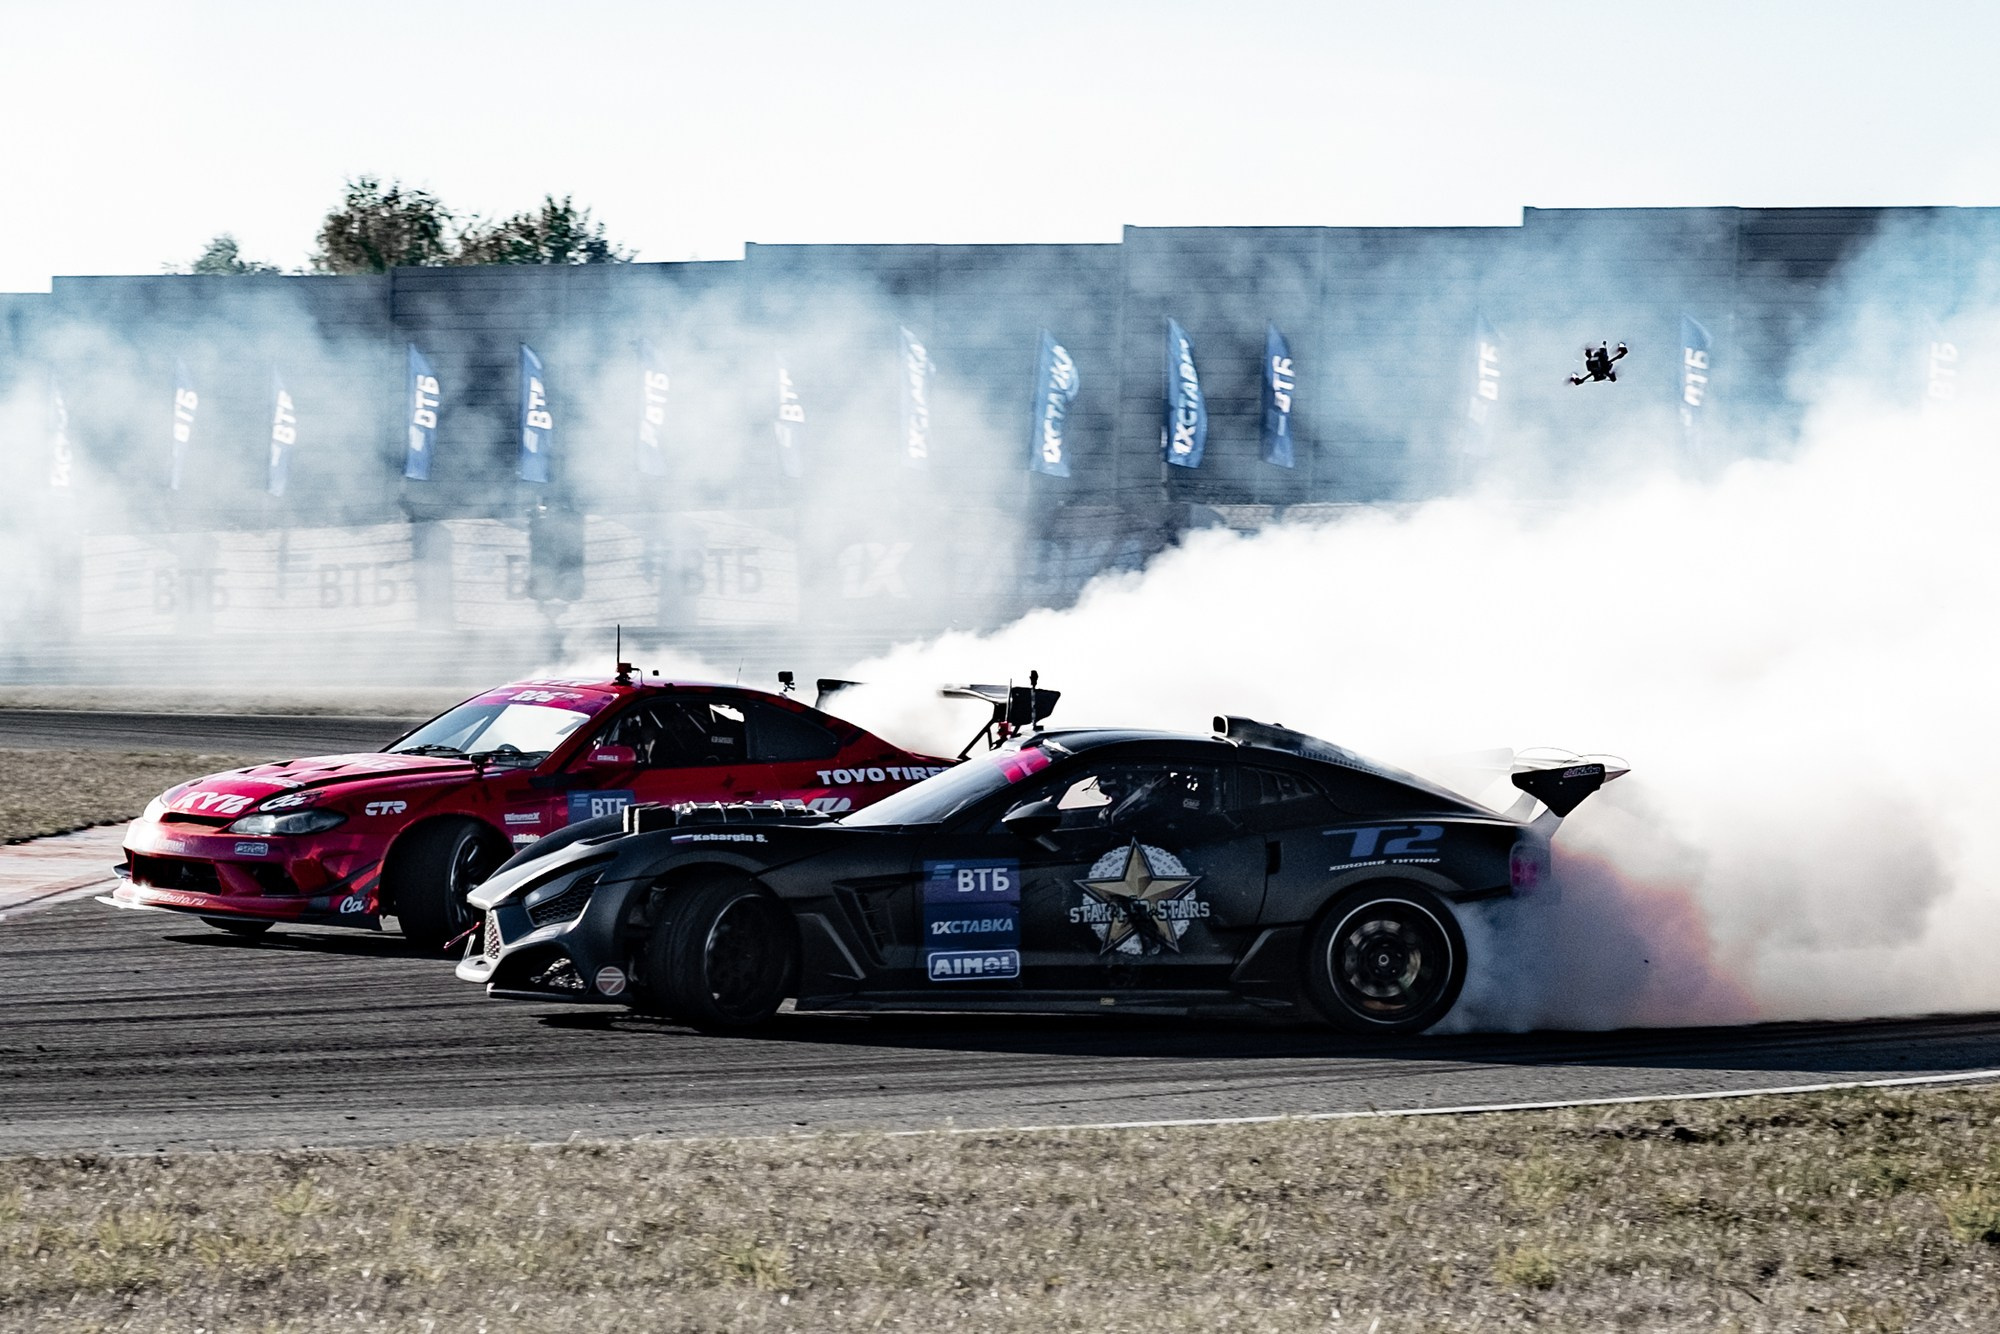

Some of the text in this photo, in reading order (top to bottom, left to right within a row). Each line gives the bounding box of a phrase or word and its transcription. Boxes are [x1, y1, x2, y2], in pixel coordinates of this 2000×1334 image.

[413, 375, 440, 429] ВТБ
[174, 388, 199, 443] ВТБ
[152, 567, 230, 617] ВТБ
[319, 560, 399, 610] ВТБ
[816, 767, 887, 785] TOYO
[173, 791, 254, 814] KYB
[365, 800, 408, 816] CTR
[1322, 825, 1445, 857] T2
[957, 867, 1011, 893] ВТБ
[1157, 899, 1211, 921] STARS
[930, 917, 1015, 936] 1ХСТАВКА
[932, 956, 1016, 977] AIMOL
